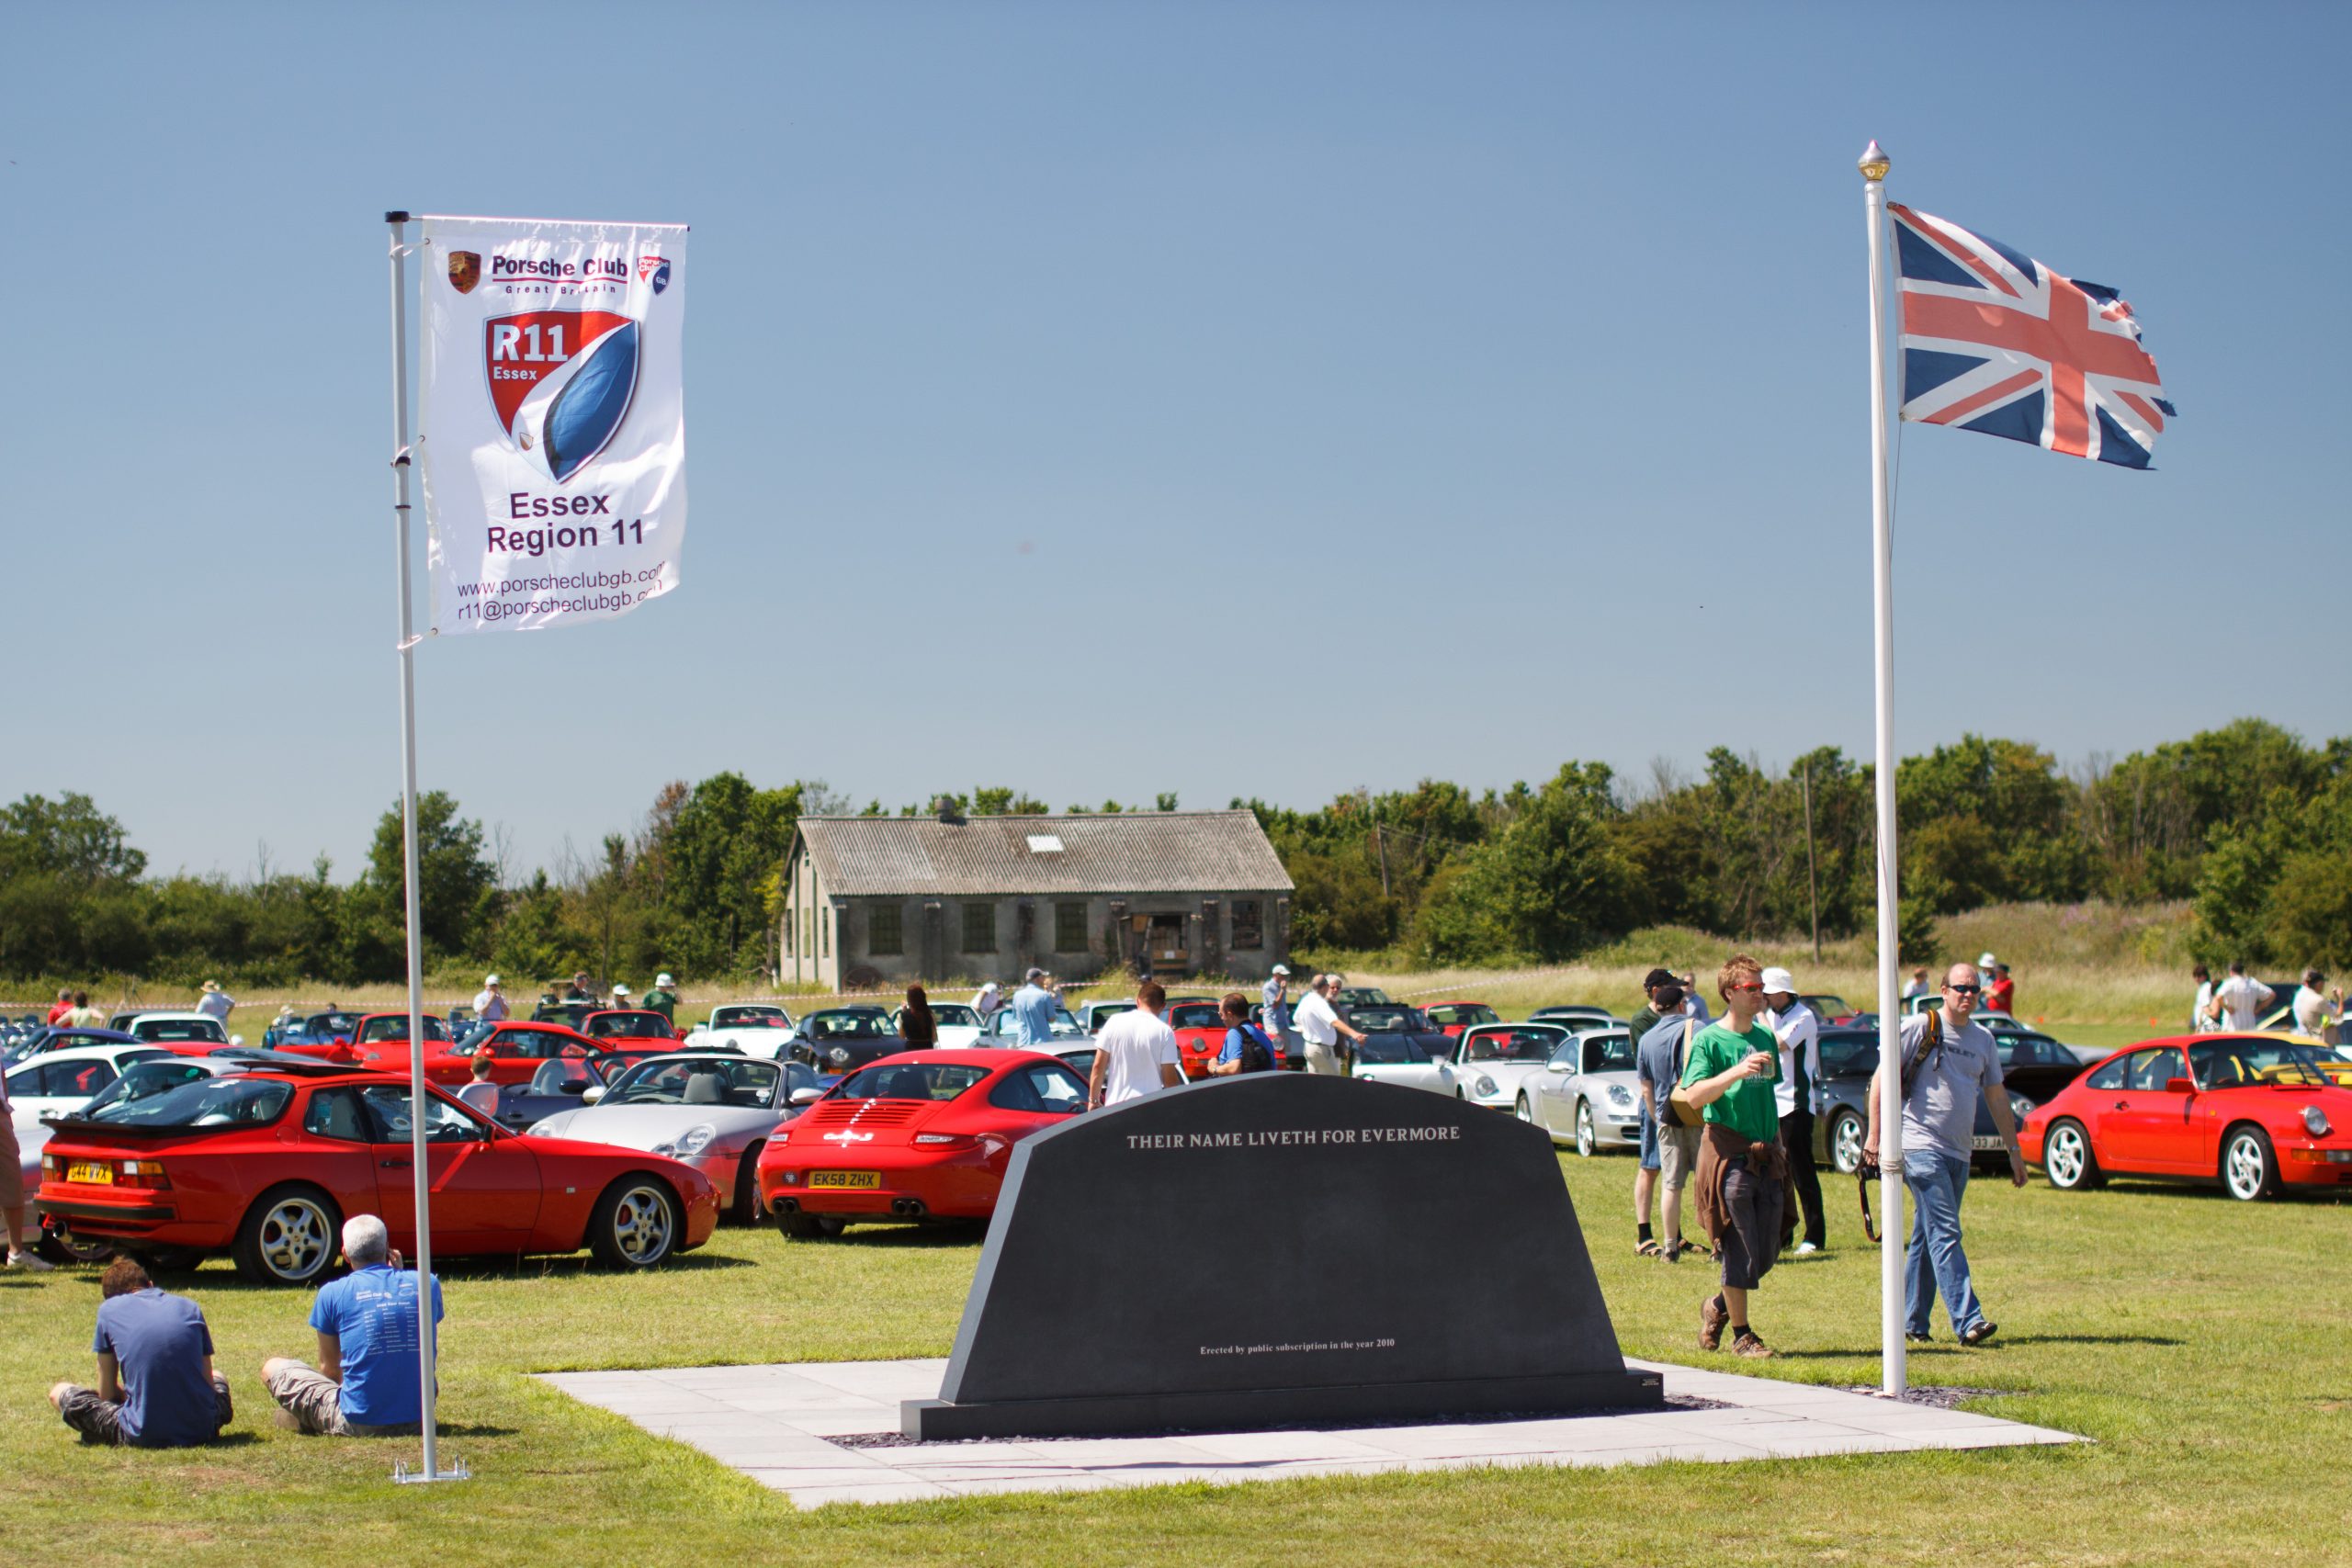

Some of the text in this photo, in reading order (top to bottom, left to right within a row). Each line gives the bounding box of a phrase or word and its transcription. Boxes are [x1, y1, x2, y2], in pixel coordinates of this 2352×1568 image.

[492, 255, 628, 276] Porsche Club
[505, 286, 549, 294] Great
[656, 276, 667, 285] GB
[493, 324, 569, 362] R11
[493, 367, 537, 380] Essex
[510, 492, 610, 519] Essex
[487, 519, 643, 557] Region 11
[1126, 1126, 1461, 1148] THEIR NAME LIVETH FOR EVERMORE
[813, 1173, 875, 1186] EK58 ZHX
[1200, 1338, 1395, 1356] Erected by public subscription in the year 2010
